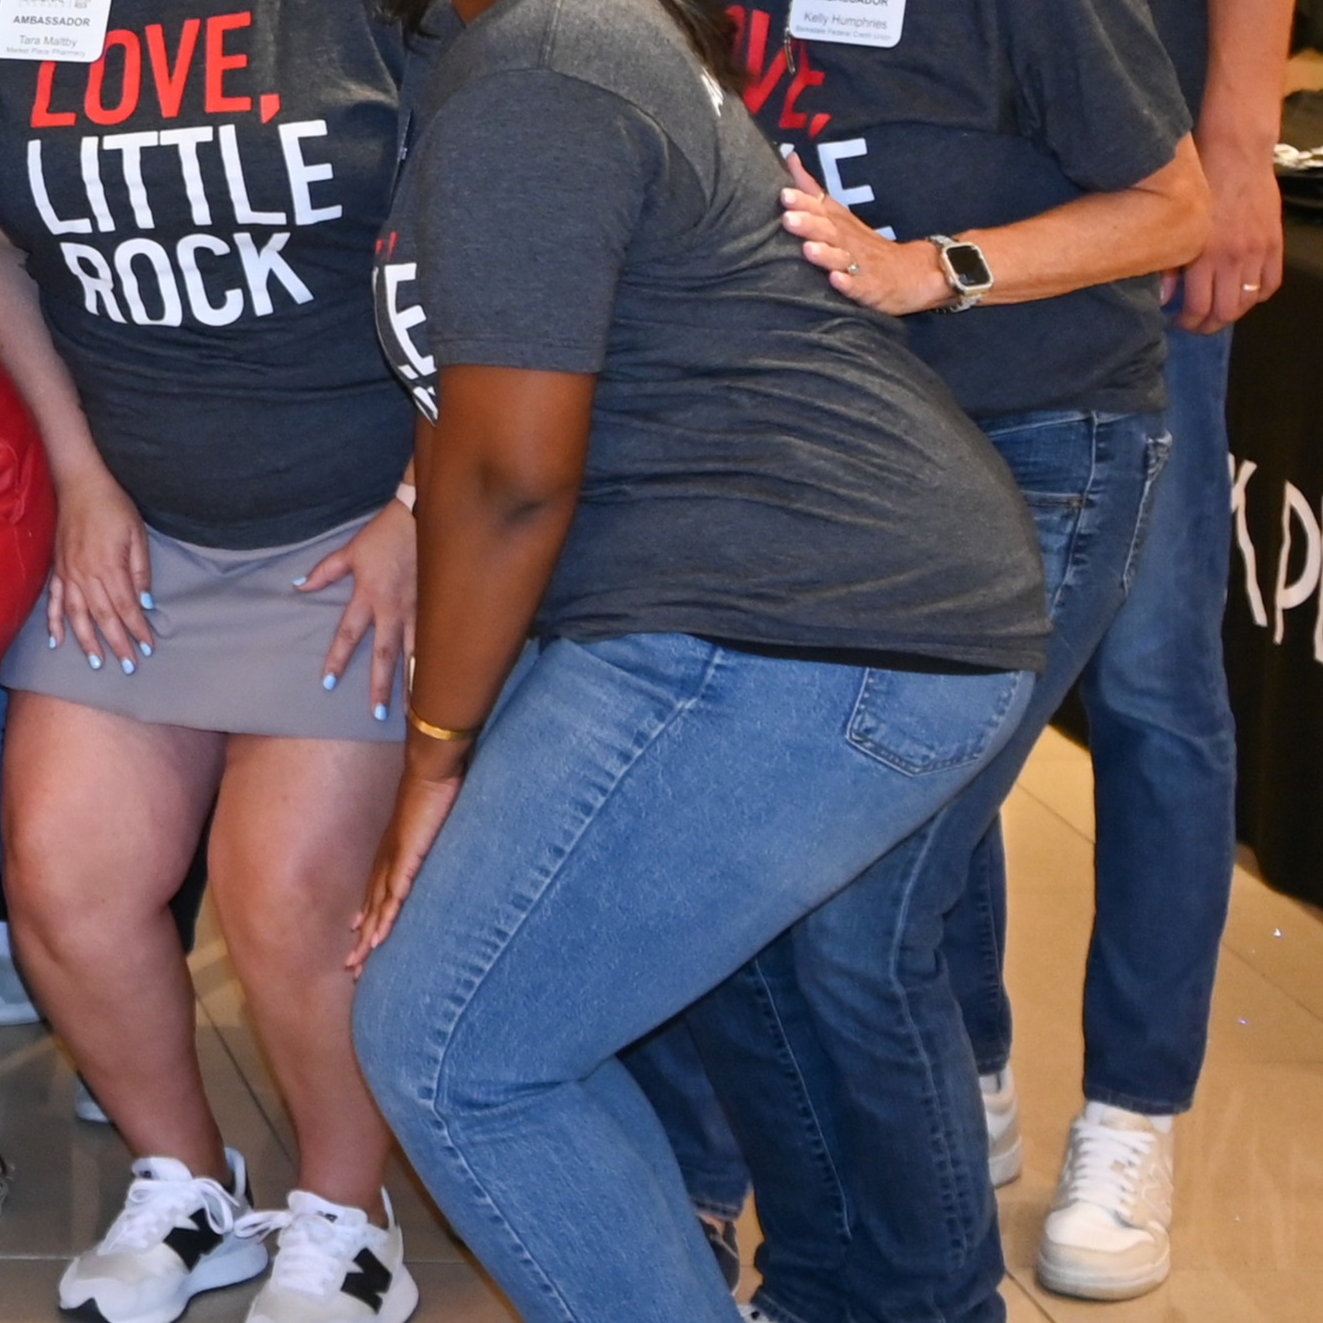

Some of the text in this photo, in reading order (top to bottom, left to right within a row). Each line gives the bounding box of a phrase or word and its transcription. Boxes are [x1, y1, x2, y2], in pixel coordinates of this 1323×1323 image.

[12, 15, 91, 27] AMBASSADOR
[19, 34, 41, 46] Tara
[803, 11, 888, 30] Kelly Humphries
[30, 11, 281, 128] LOVE,
[27, 119, 343, 234] LITTLE
[60, 231, 314, 328] ROCK
